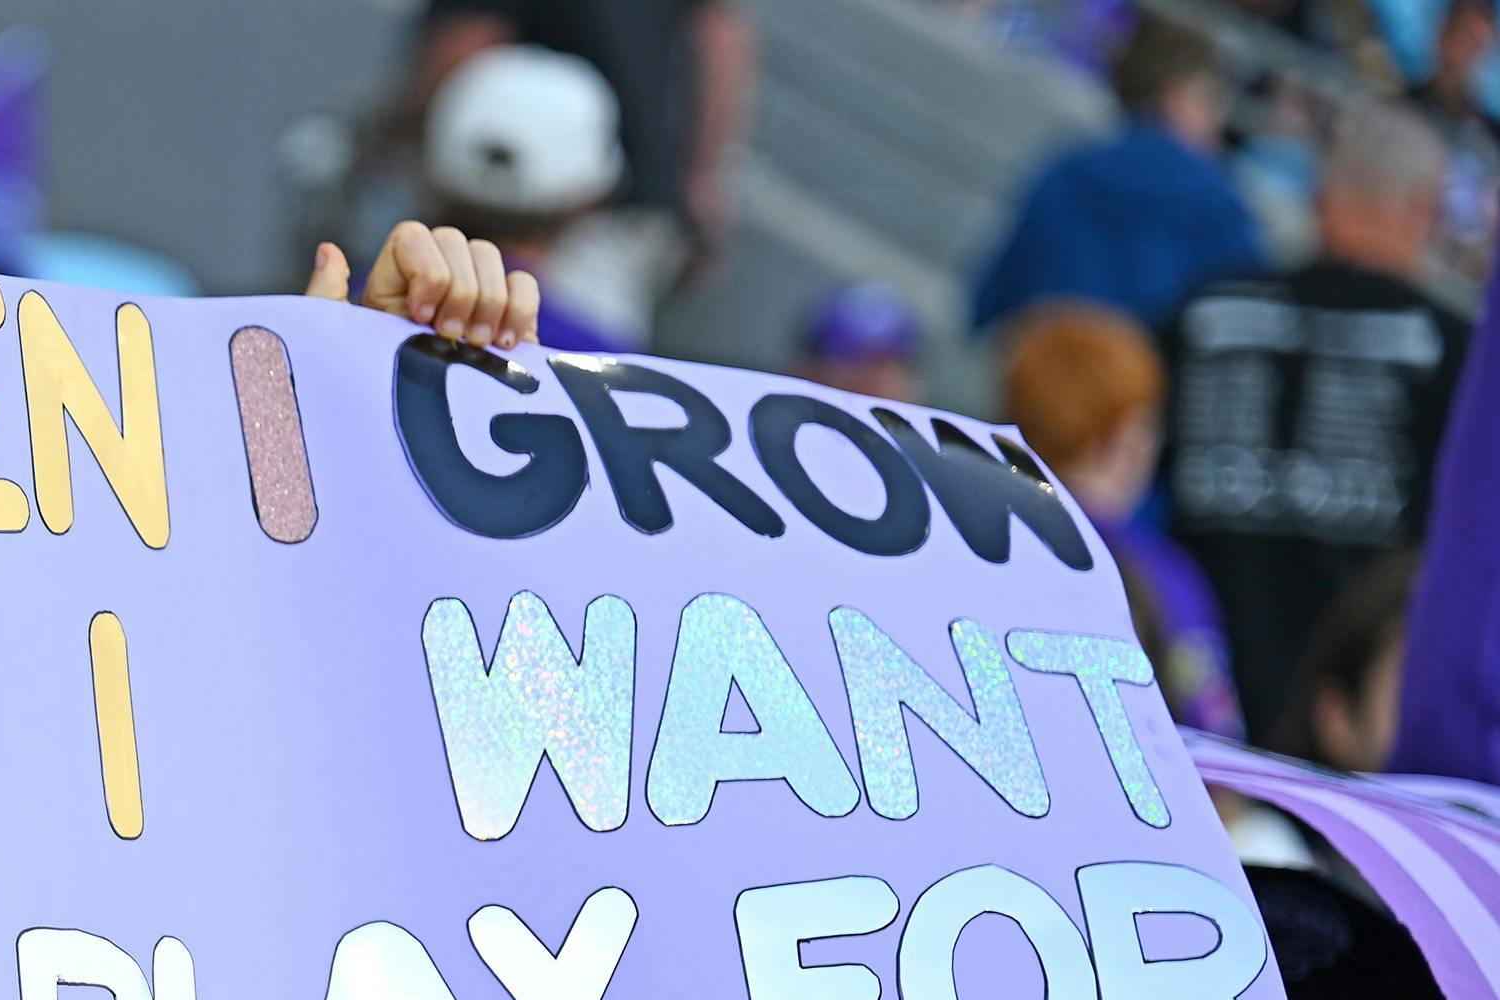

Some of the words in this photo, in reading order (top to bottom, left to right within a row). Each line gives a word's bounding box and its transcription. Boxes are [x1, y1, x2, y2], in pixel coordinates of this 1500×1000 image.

[229, 325, 319, 544] I
[393, 333, 1095, 571] GROW
[88, 610, 144, 841] I
[421, 589, 1172, 841] WANT
